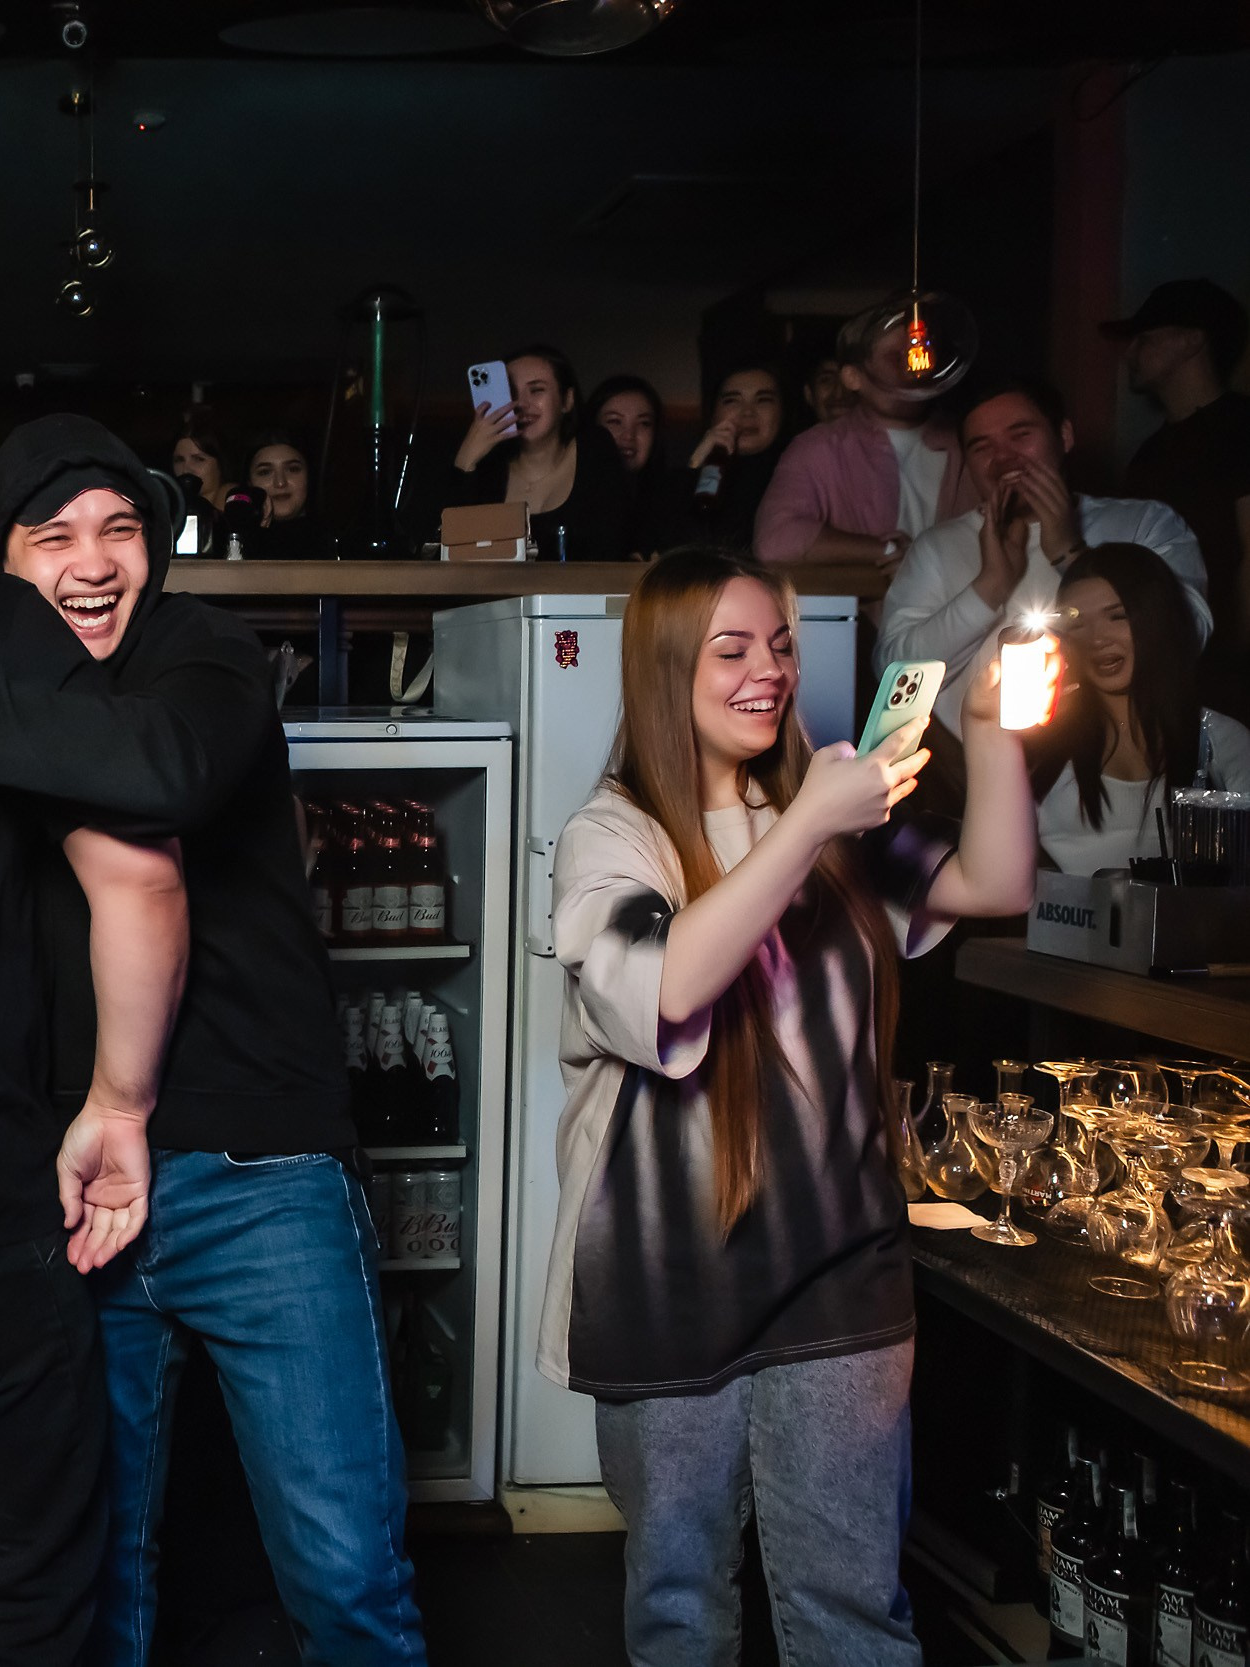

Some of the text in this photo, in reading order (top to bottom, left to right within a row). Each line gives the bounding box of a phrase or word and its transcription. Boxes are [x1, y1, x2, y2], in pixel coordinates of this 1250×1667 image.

[378, 911, 404, 922] Bud
[414, 909, 441, 920] Bud
[1037, 902, 1097, 930] ABSOLUT.
